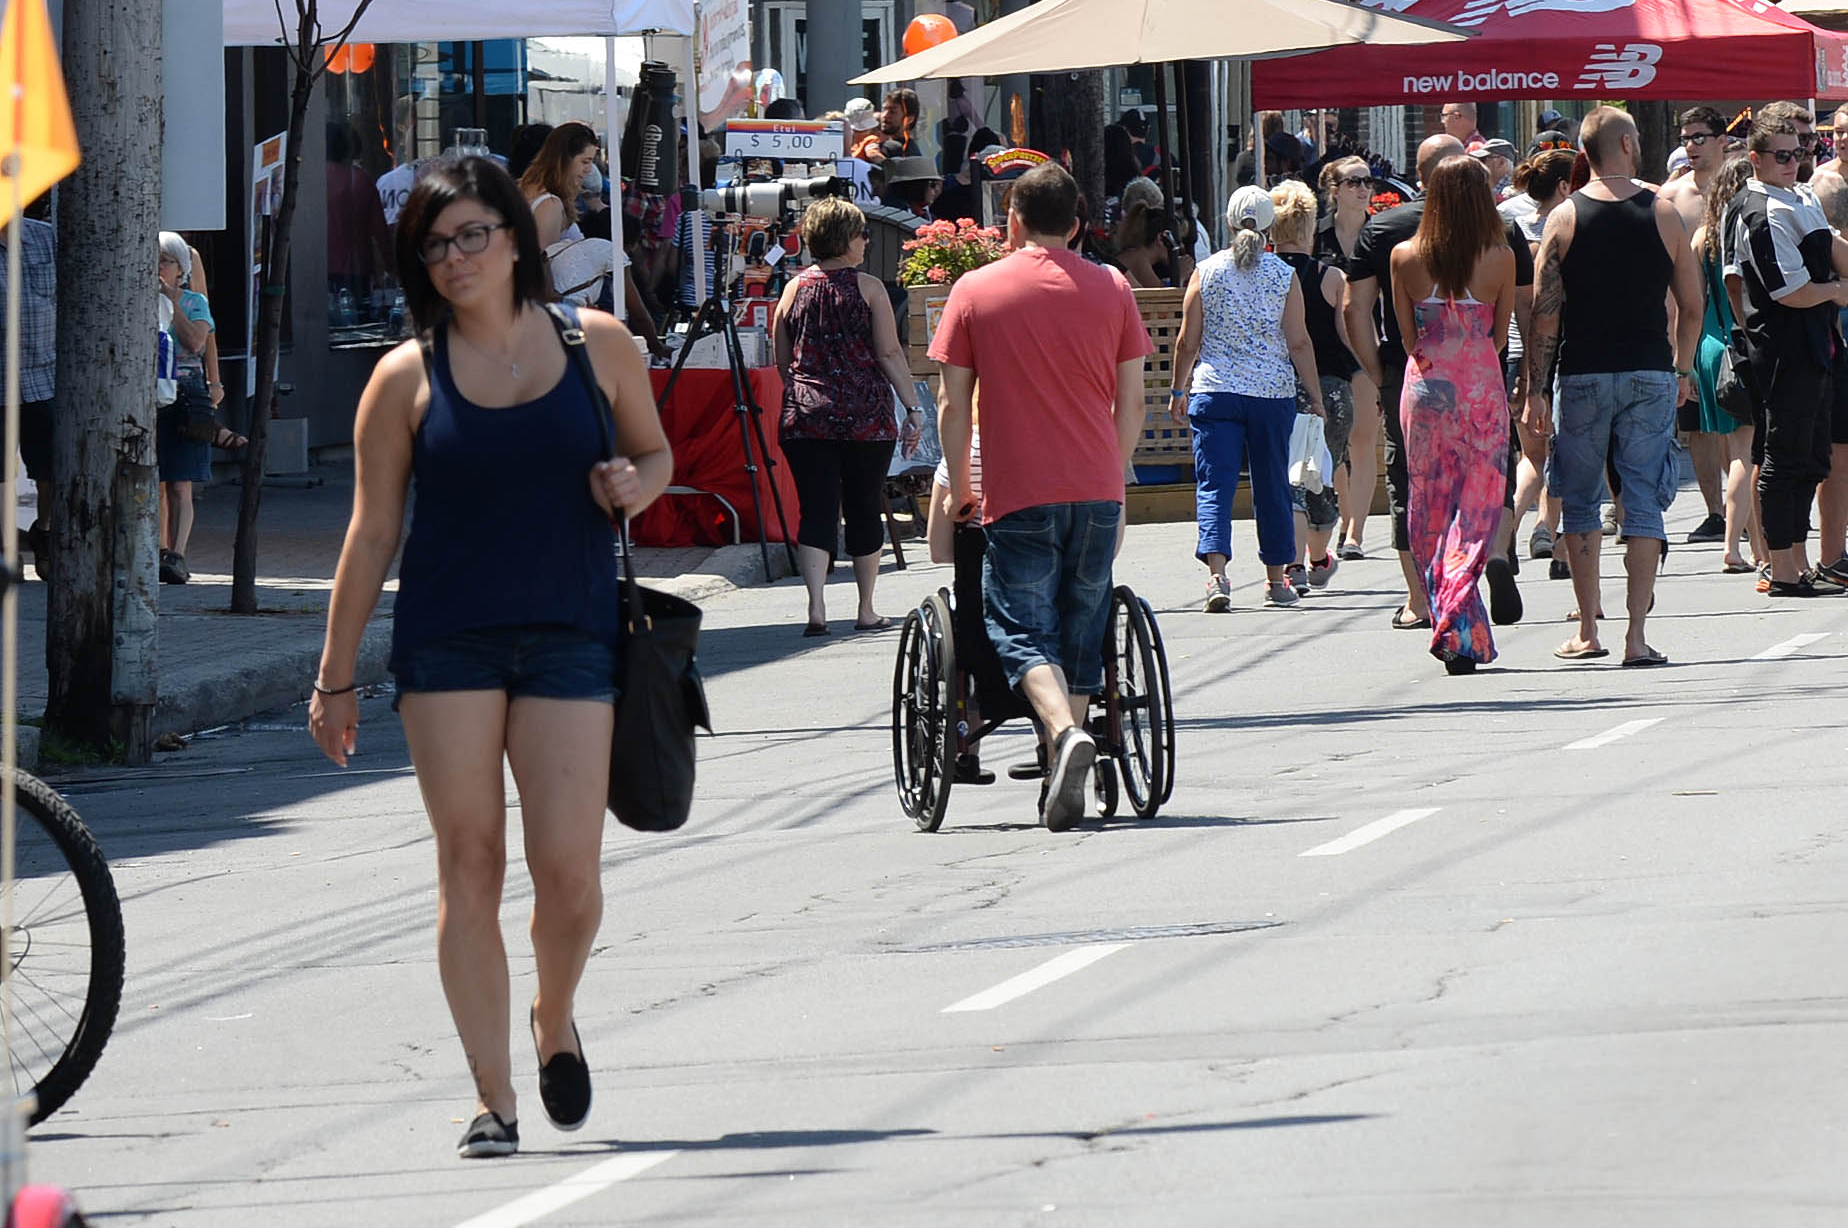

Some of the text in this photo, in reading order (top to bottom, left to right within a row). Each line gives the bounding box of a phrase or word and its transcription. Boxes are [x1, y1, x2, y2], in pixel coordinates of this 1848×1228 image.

[1573, 43, 1664, 90] NB
[1403, 70, 1560, 93] new balance
[772, 124, 796, 133] Etui
[750, 134, 761, 148] $
[641, 129, 664, 186] Bushnell
